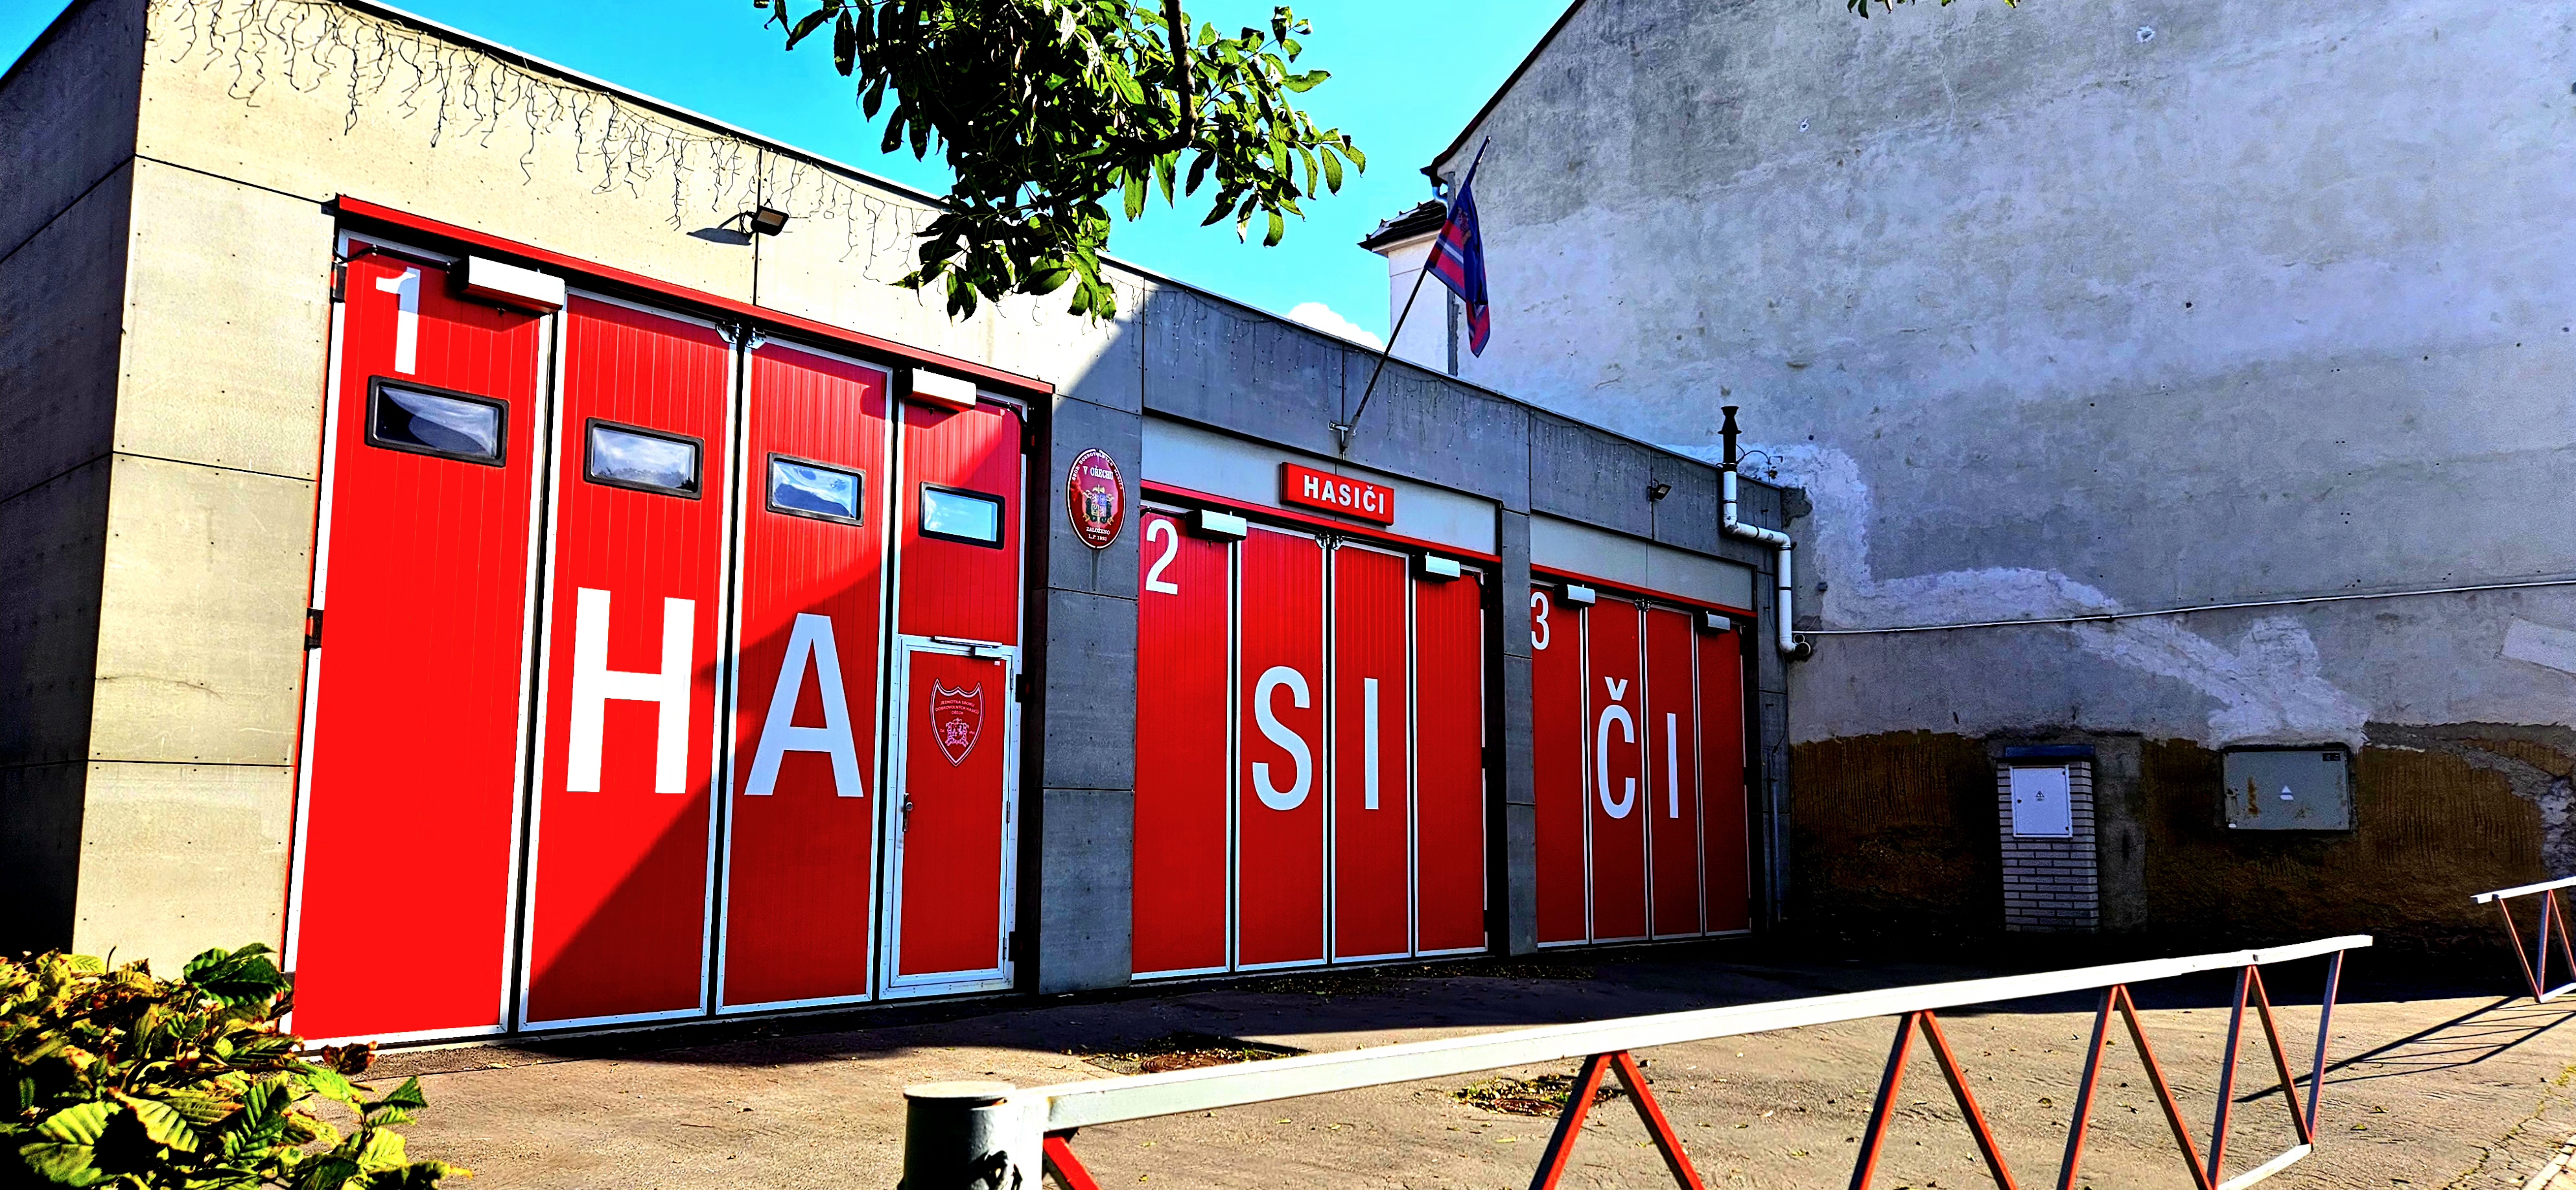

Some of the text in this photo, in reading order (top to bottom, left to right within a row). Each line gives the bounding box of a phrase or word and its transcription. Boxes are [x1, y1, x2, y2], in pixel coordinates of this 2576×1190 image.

[375, 266, 421, 375] 1
[1083, 465, 1114, 480] V OŘECHU
[1304, 474, 1384, 515] HASIČI
[1086, 526, 1110, 535] ZALOŽENO
[1145, 519, 1179, 595] 2
[1530, 591, 1550, 650] 3
